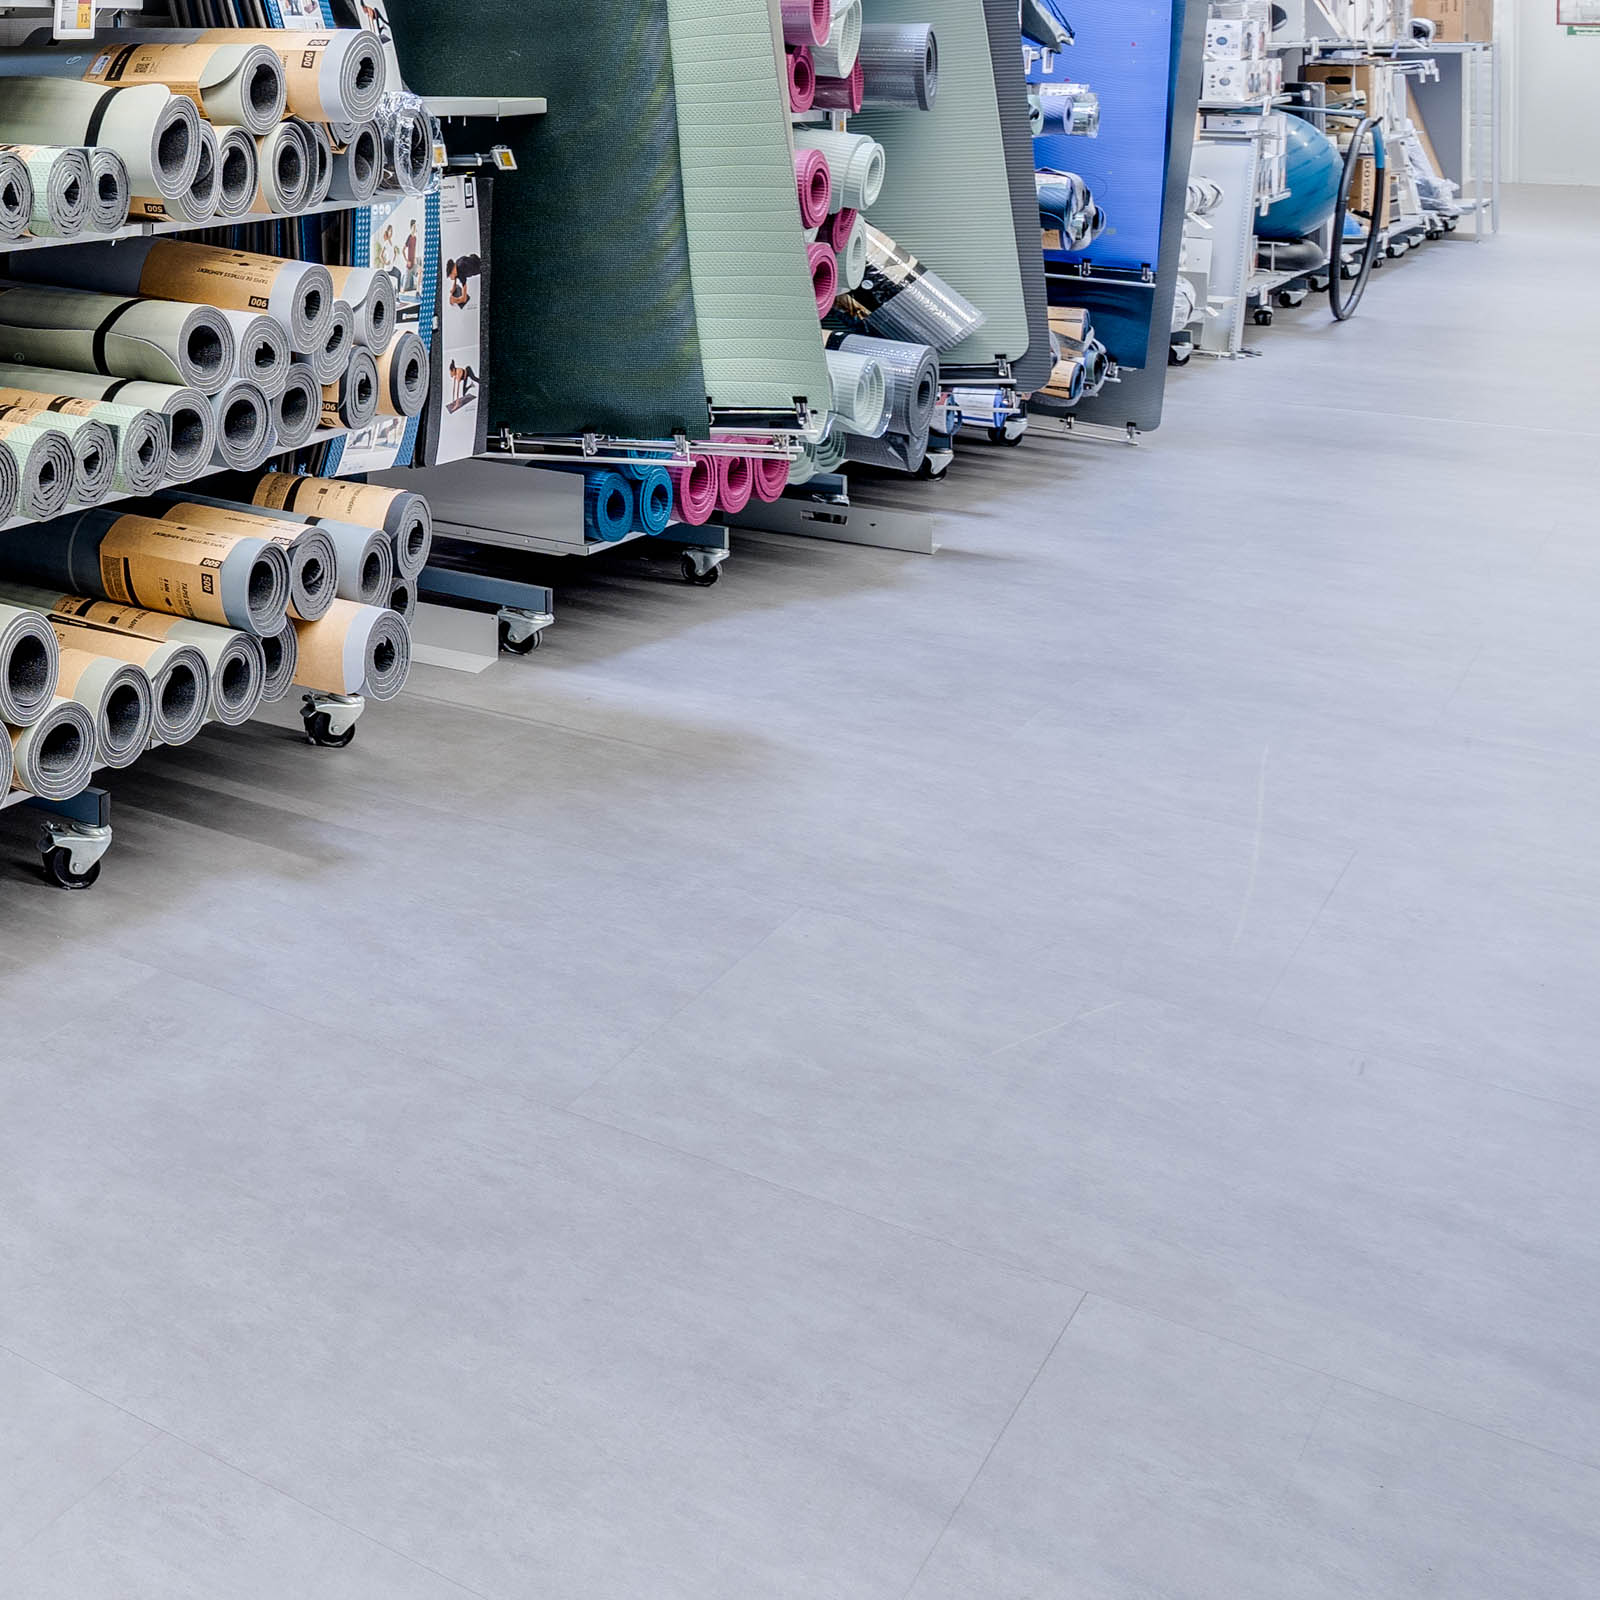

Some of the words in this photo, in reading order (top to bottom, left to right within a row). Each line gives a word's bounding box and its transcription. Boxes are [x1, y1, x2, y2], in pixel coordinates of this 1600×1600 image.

[145, 203, 164, 213] 500
[250, 297, 268, 308] 900
[202, 558, 221, 568] 500
[202, 575, 212, 592] 500
[181, 582, 189, 599] TAPIS
